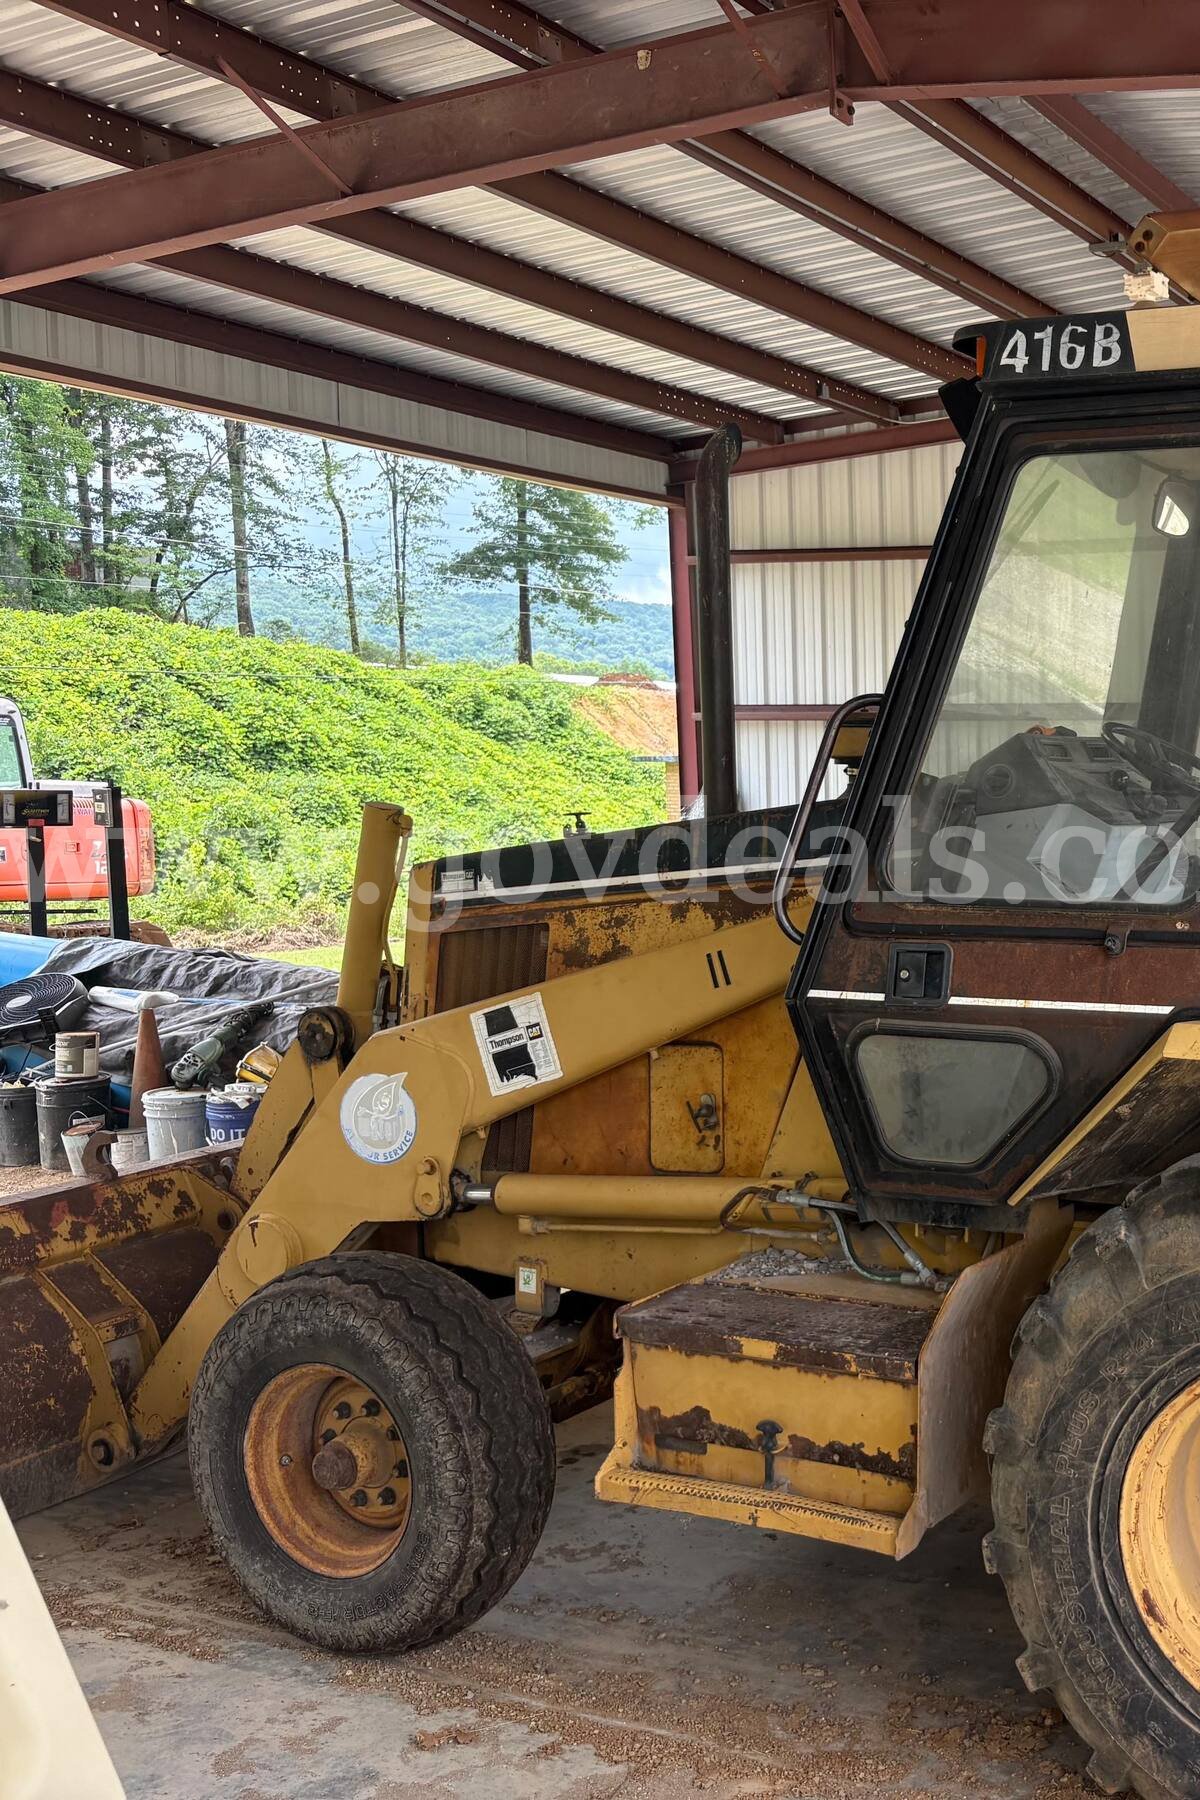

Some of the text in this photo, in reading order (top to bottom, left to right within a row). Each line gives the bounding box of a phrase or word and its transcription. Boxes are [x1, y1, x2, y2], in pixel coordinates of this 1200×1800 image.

[1000, 320, 1122, 374] 416B
[489, 1025, 541, 1050] Thompson CAT
[382, 1129, 414, 1161] SERVICE
